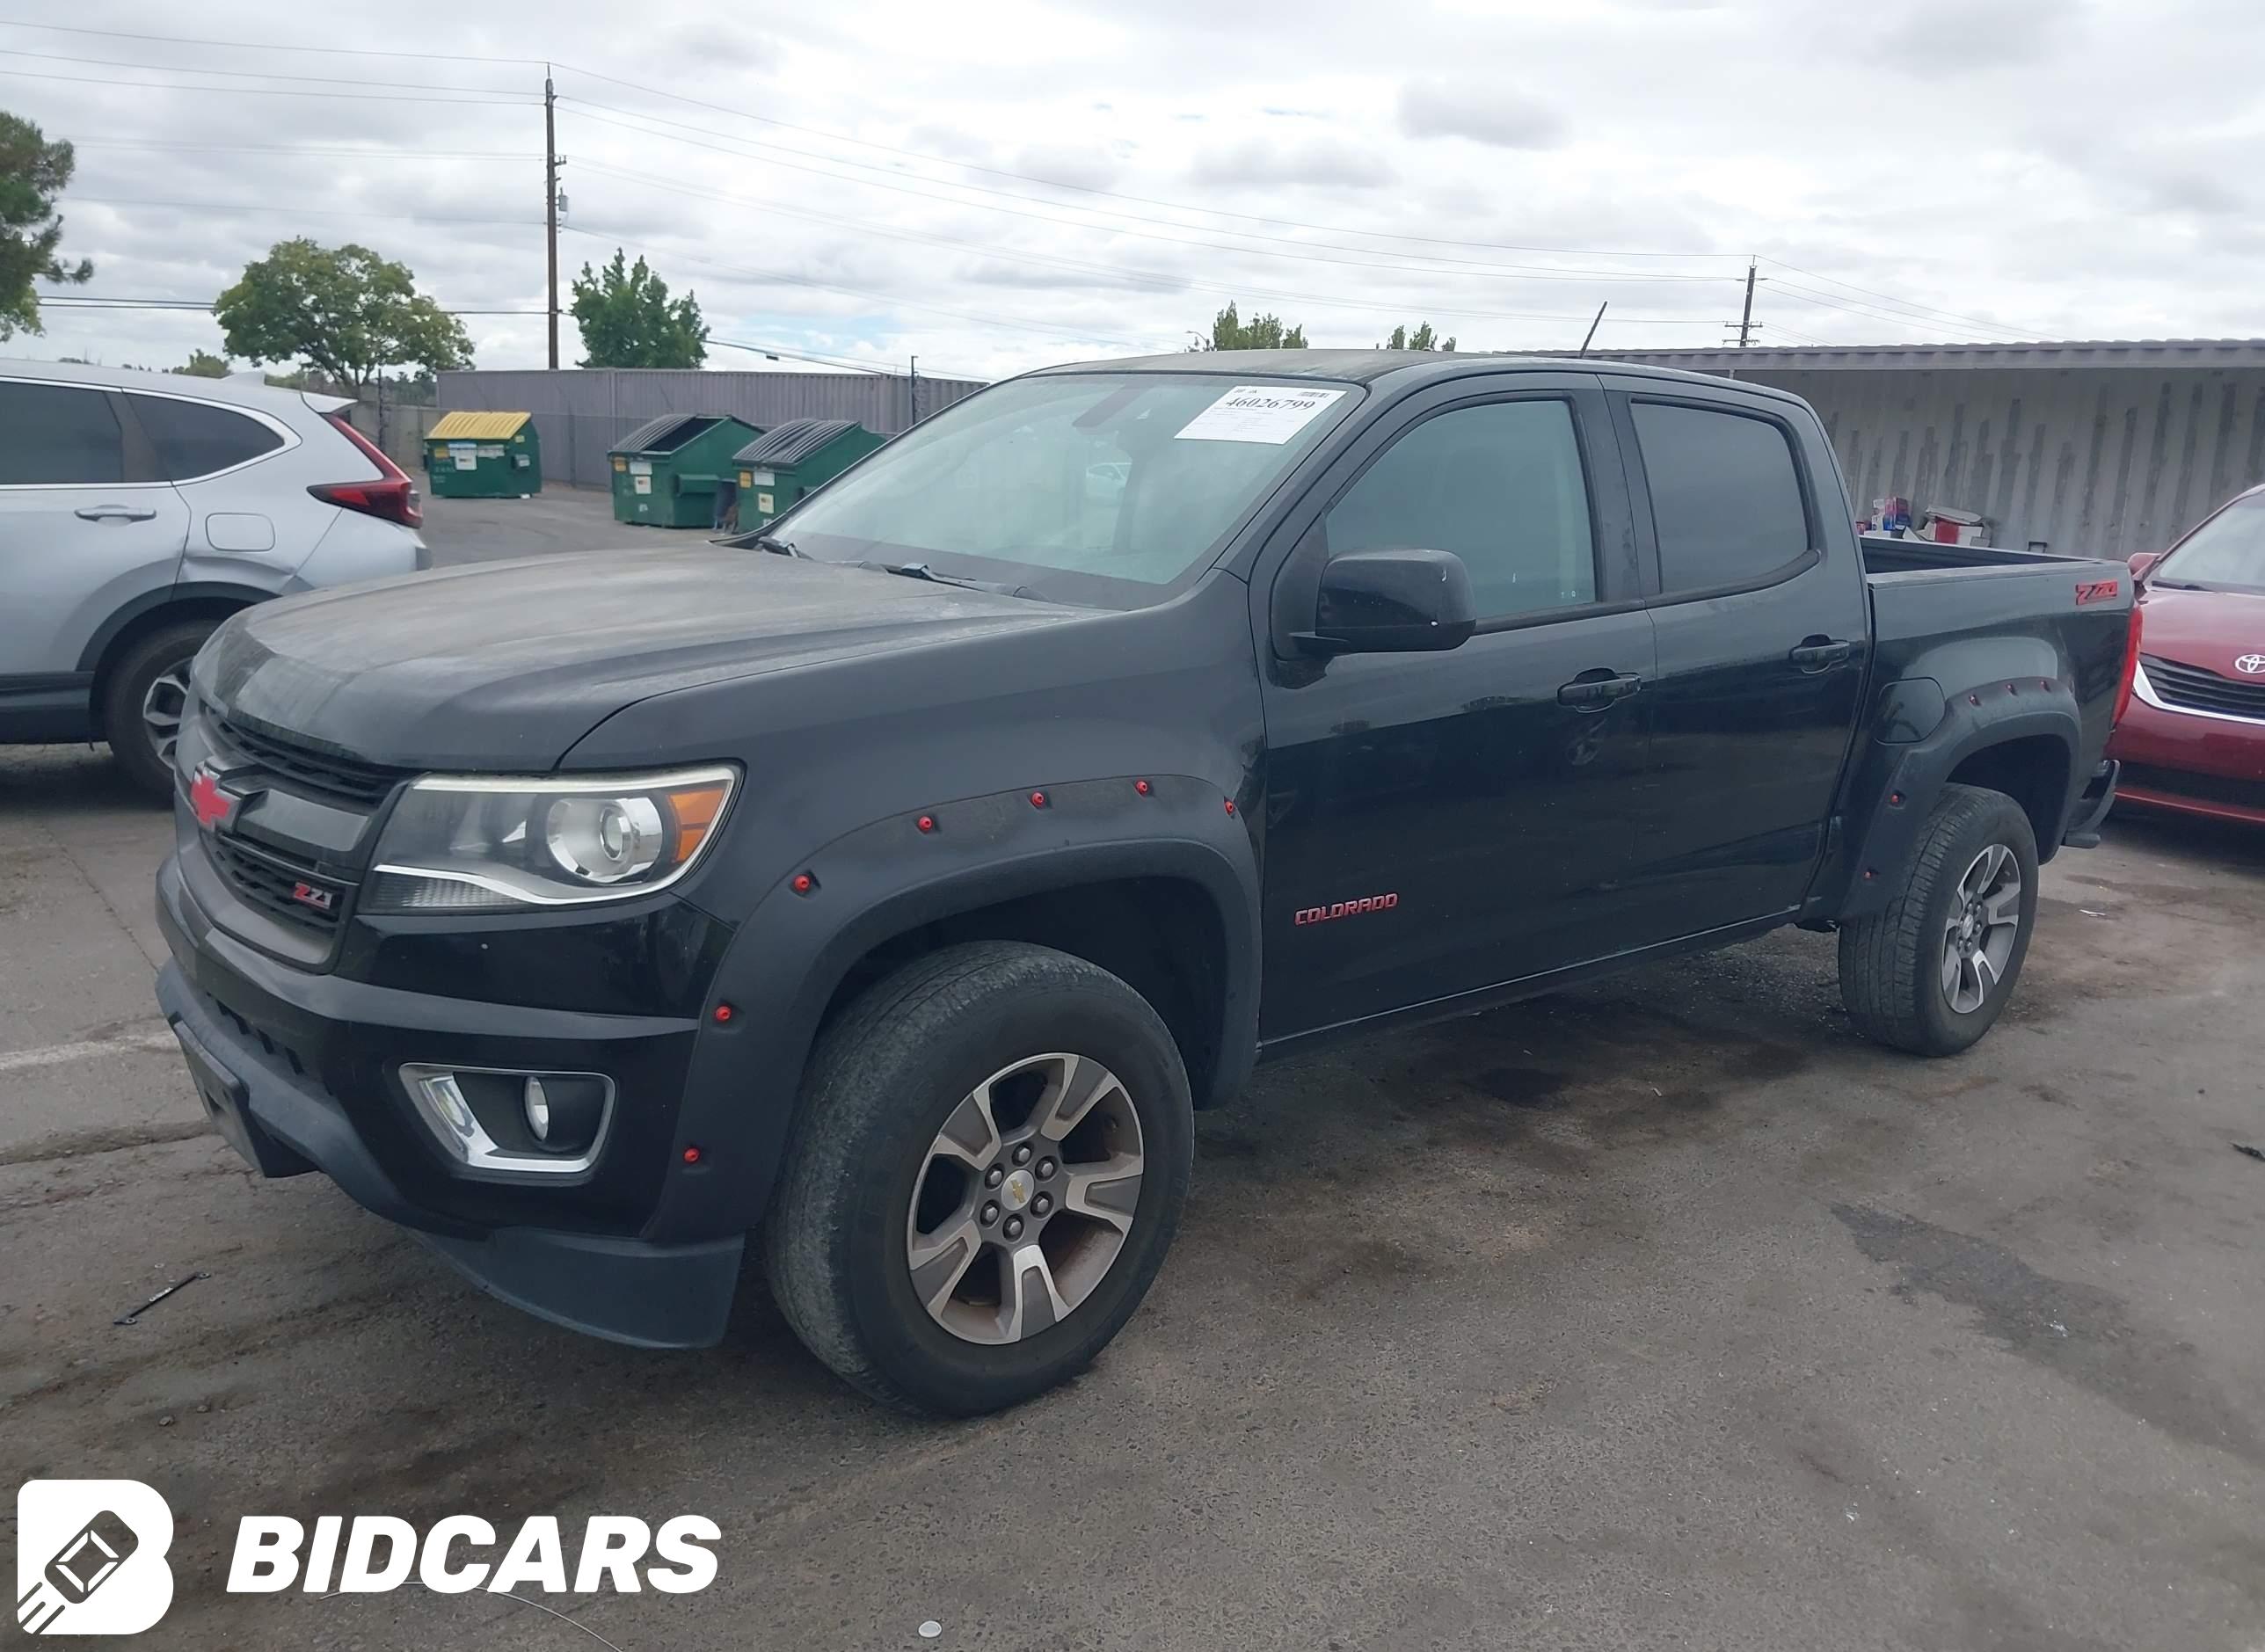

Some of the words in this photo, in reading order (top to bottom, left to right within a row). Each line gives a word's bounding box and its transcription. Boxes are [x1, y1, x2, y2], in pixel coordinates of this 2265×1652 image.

[1226, 397, 1316, 411] 46026799
[295, 882, 333, 910] Z71
[1294, 892, 1398, 926] COLORADO
